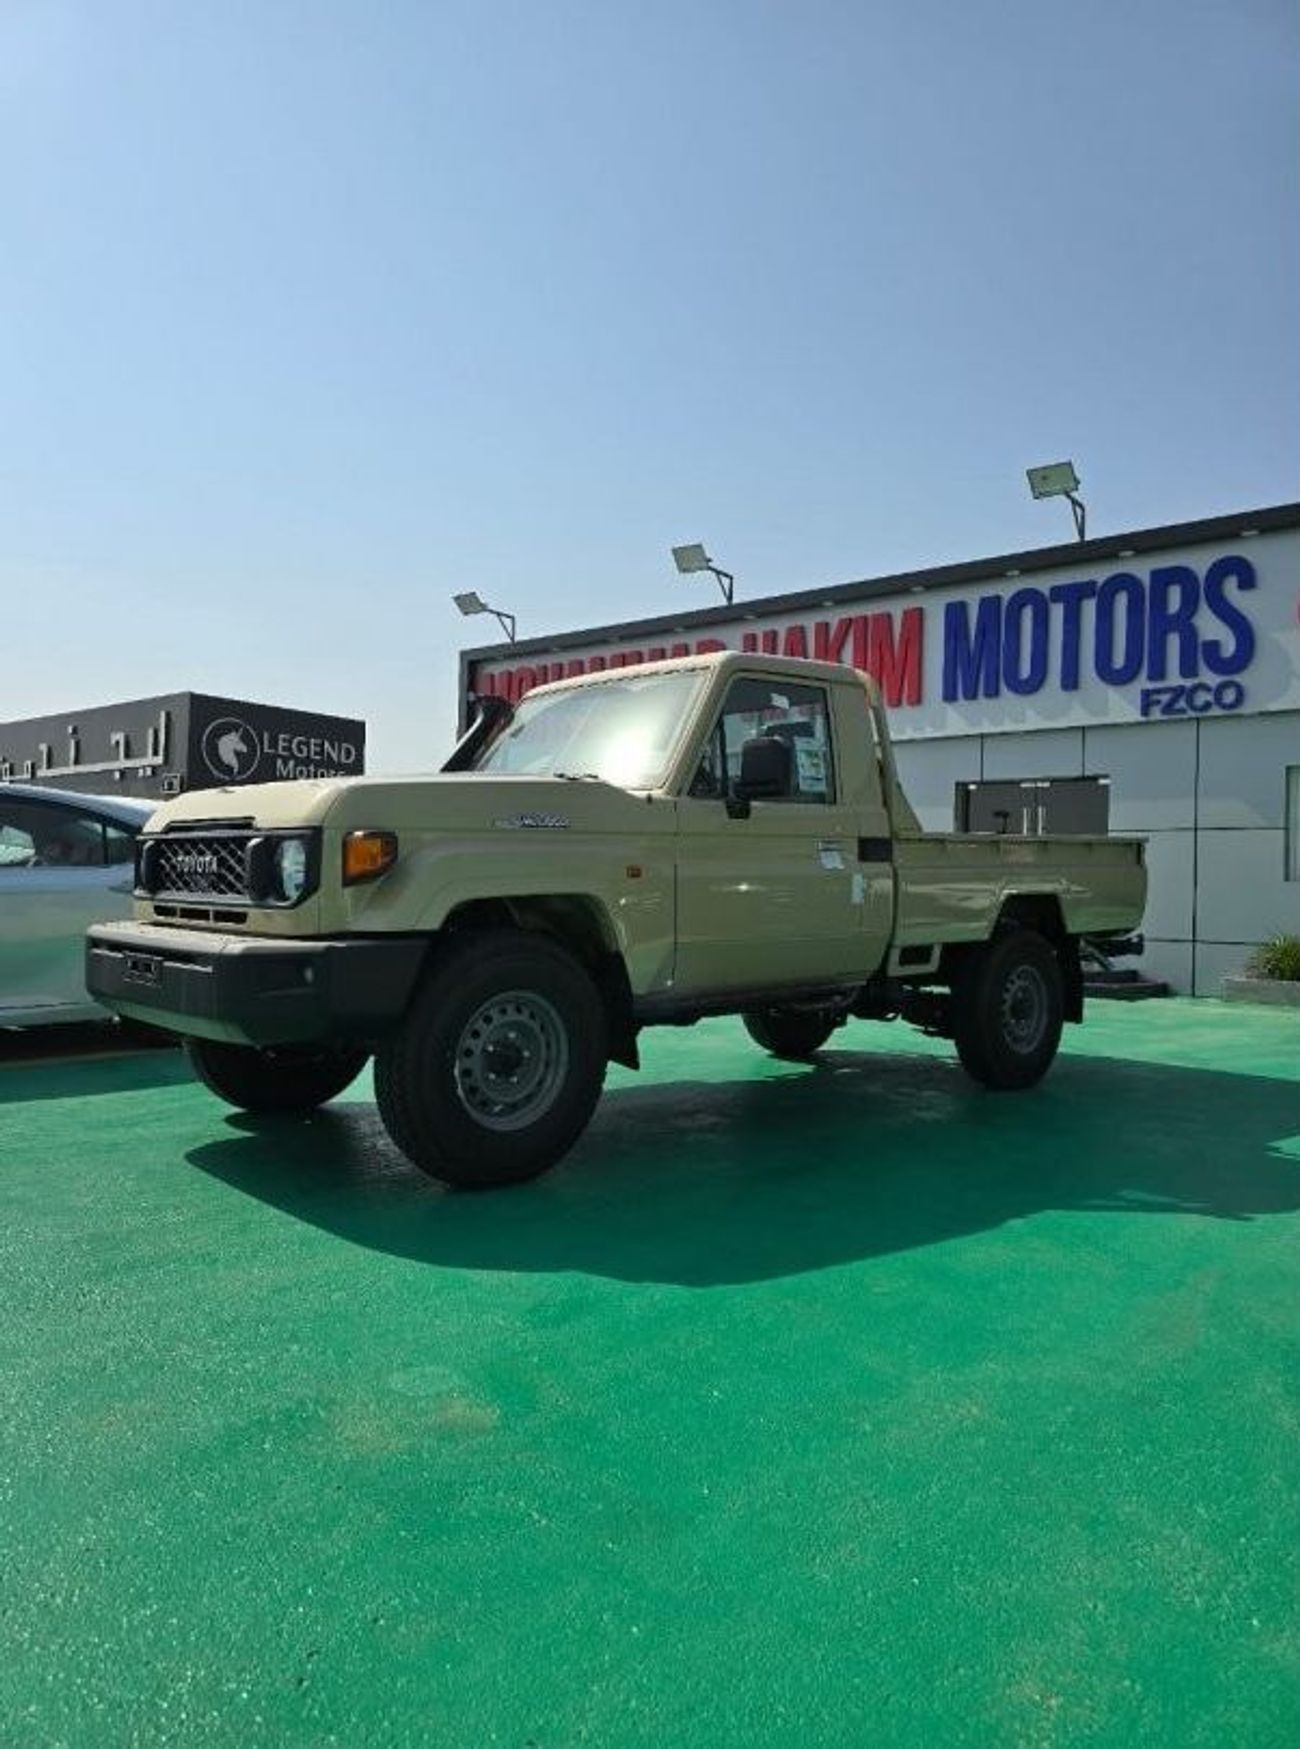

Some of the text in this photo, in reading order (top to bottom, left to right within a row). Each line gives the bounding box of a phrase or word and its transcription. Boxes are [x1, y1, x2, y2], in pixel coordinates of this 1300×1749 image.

[743, 607, 923, 707] KIM
[942, 555, 1257, 703] MOTORS
[1140, 680, 1245, 717] FZCO
[263, 731, 356, 764] LEGEND
